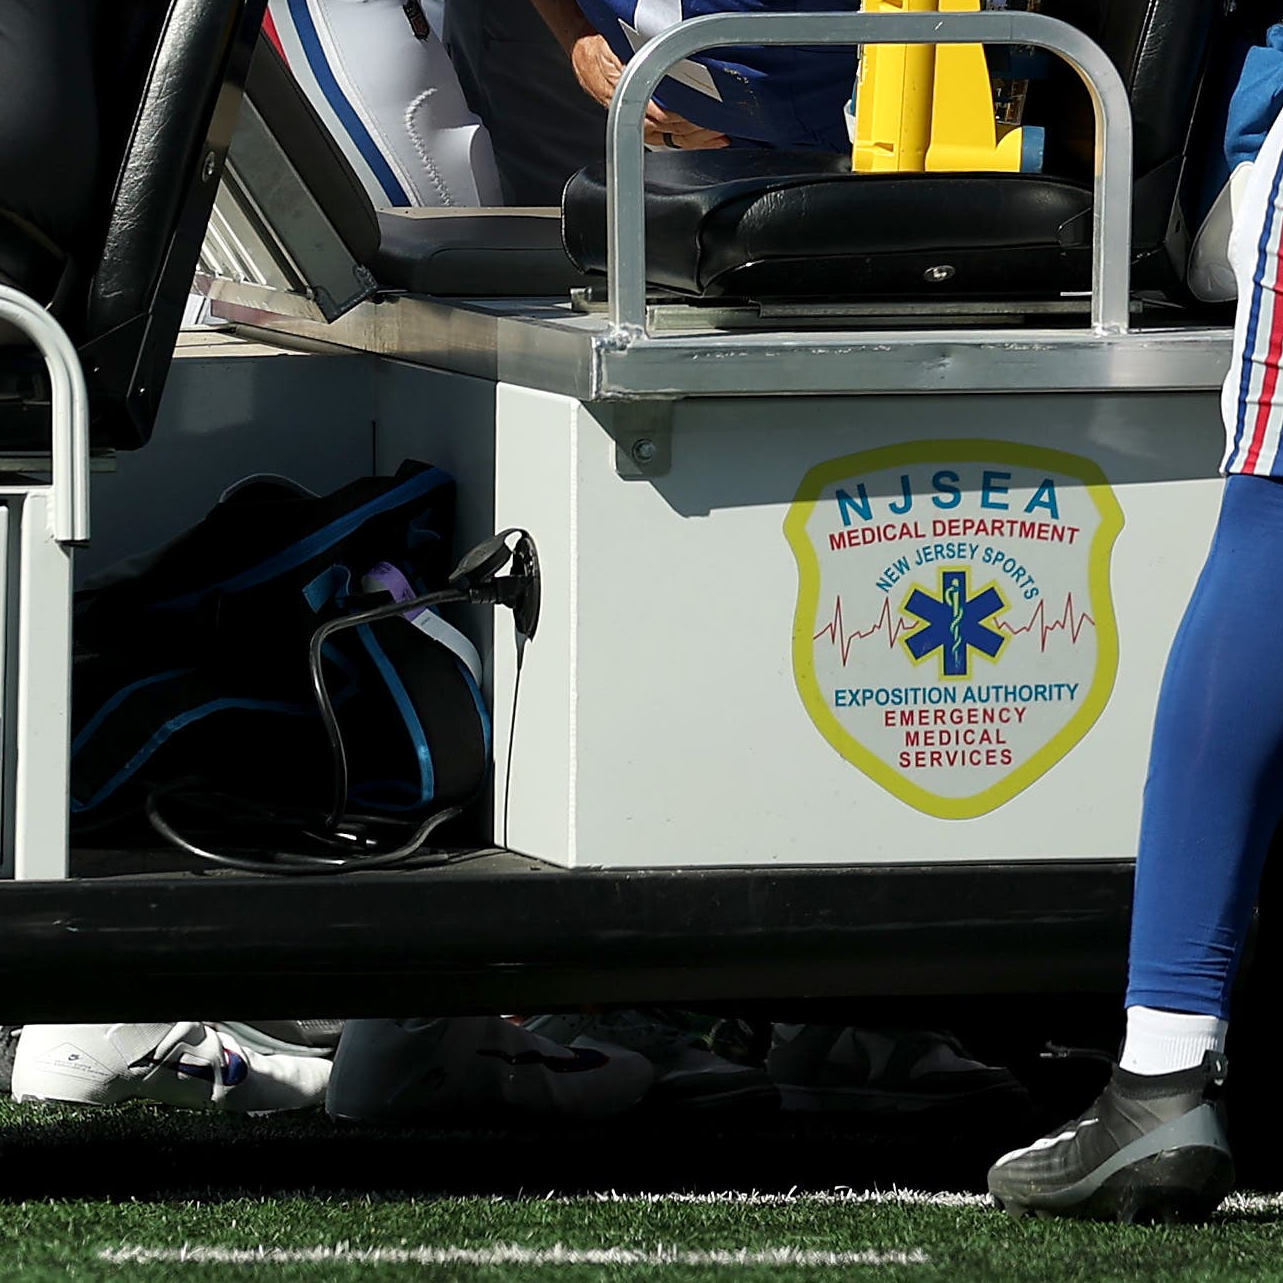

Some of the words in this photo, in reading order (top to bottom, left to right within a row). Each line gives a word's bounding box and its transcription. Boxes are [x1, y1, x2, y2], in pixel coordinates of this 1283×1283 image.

[834, 469, 1061, 527] NJSEA
[828, 521, 926, 551] MEDICAL
[932, 518, 1080, 546] DEPARTMENT
[875, 555, 912, 594] NEW
[914, 541, 980, 567] JERSEY
[982, 546, 1040, 602] SPORTS
[834, 685, 957, 708] EXPOSITION
[962, 682, 1080, 704] AUTHORITY
[884, 707, 1028, 728] EMERGENCY
[904, 728, 1007, 748] MEDICAL
[898, 748, 1013, 769] SERVICES
